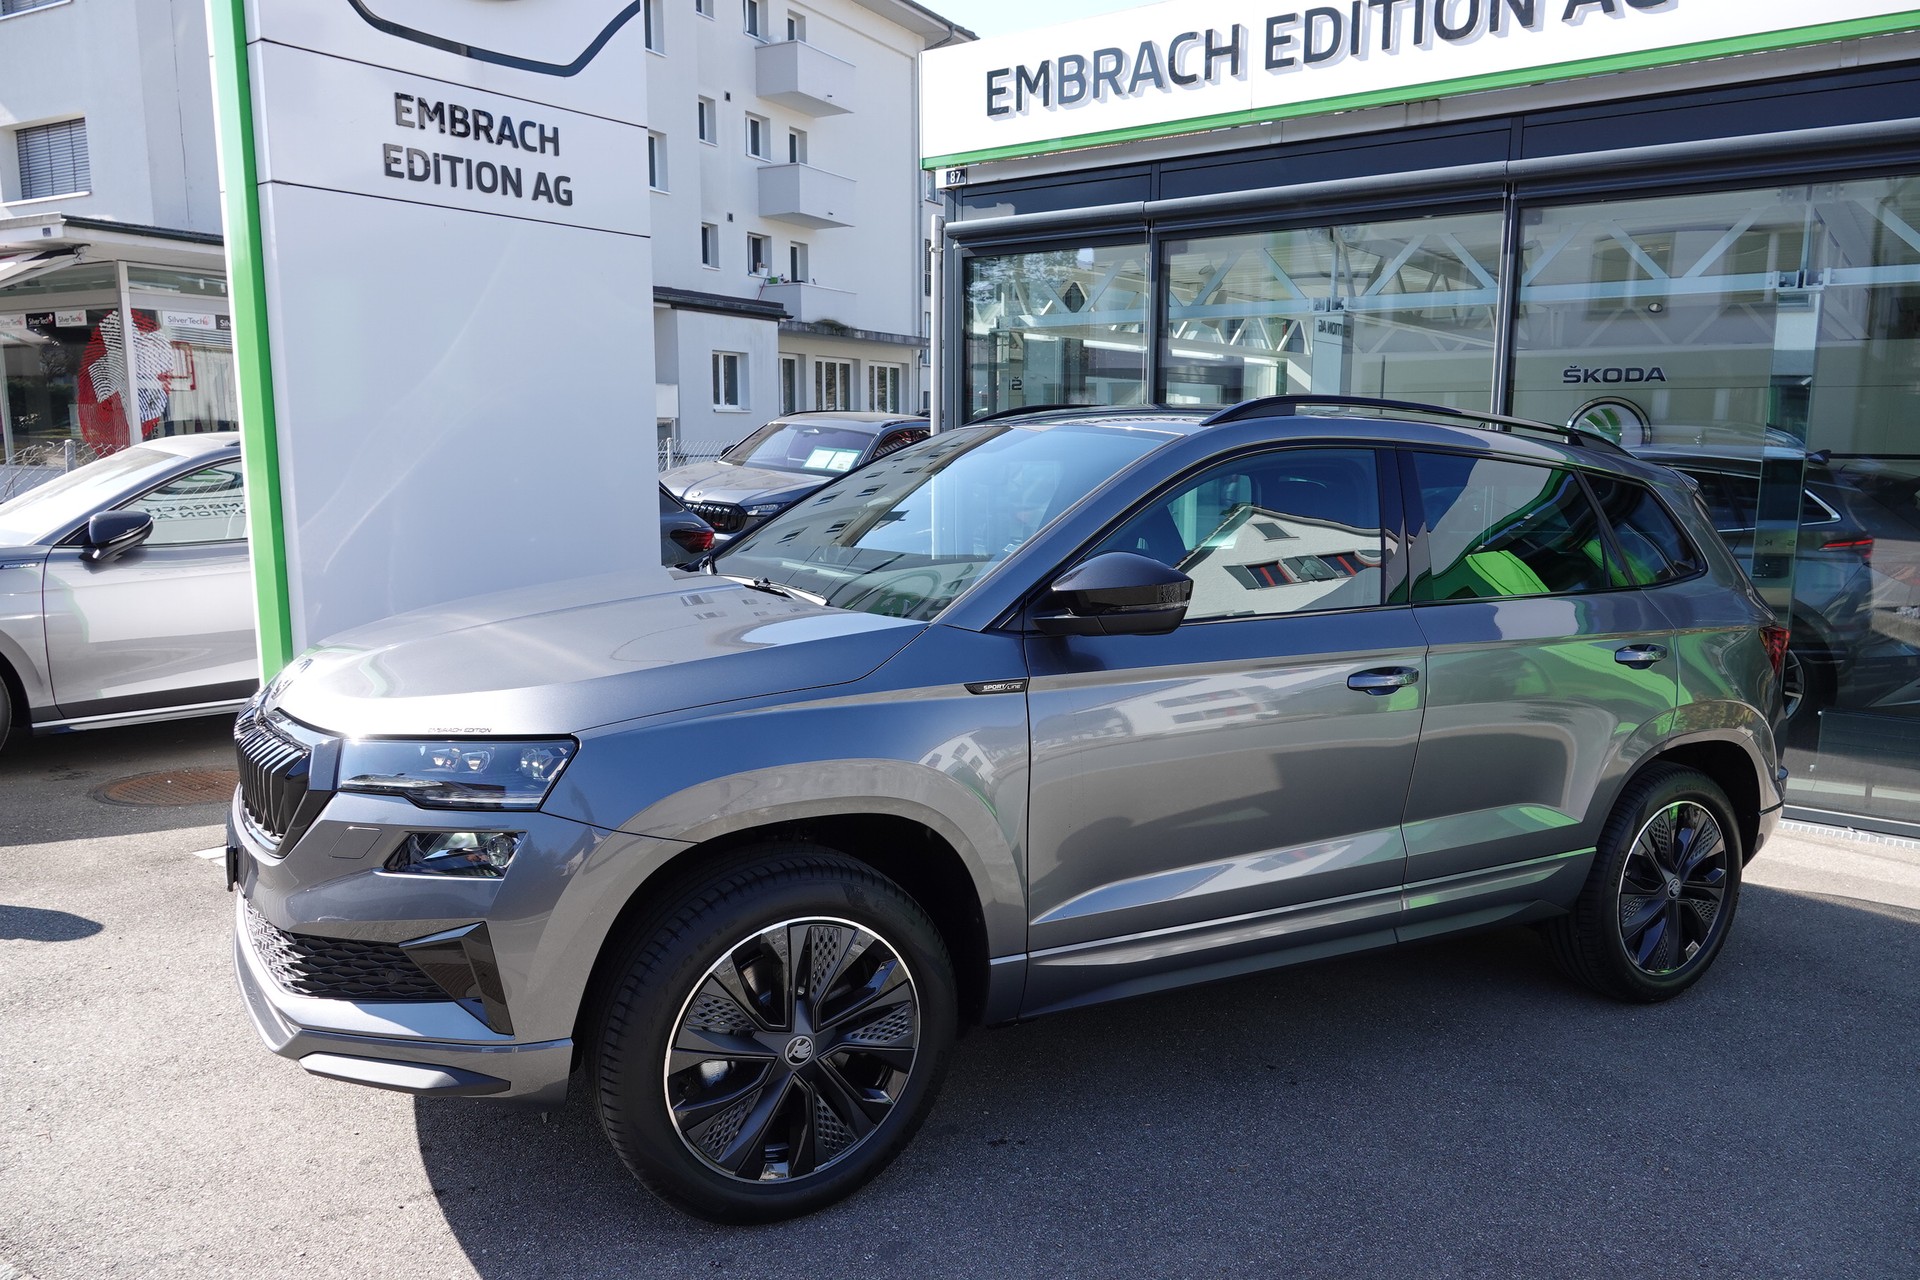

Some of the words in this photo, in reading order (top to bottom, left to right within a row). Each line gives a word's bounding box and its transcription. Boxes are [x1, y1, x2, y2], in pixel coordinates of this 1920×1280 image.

[986, 24, 1243, 117] EMBRACH
[394, 92, 560, 156] EMBRACH
[383, 143, 523, 198] EDITION
[532, 172, 573, 206] AG
[950, 170, 961, 183] 87
[1563, 365, 1667, 384] ŠKODA
